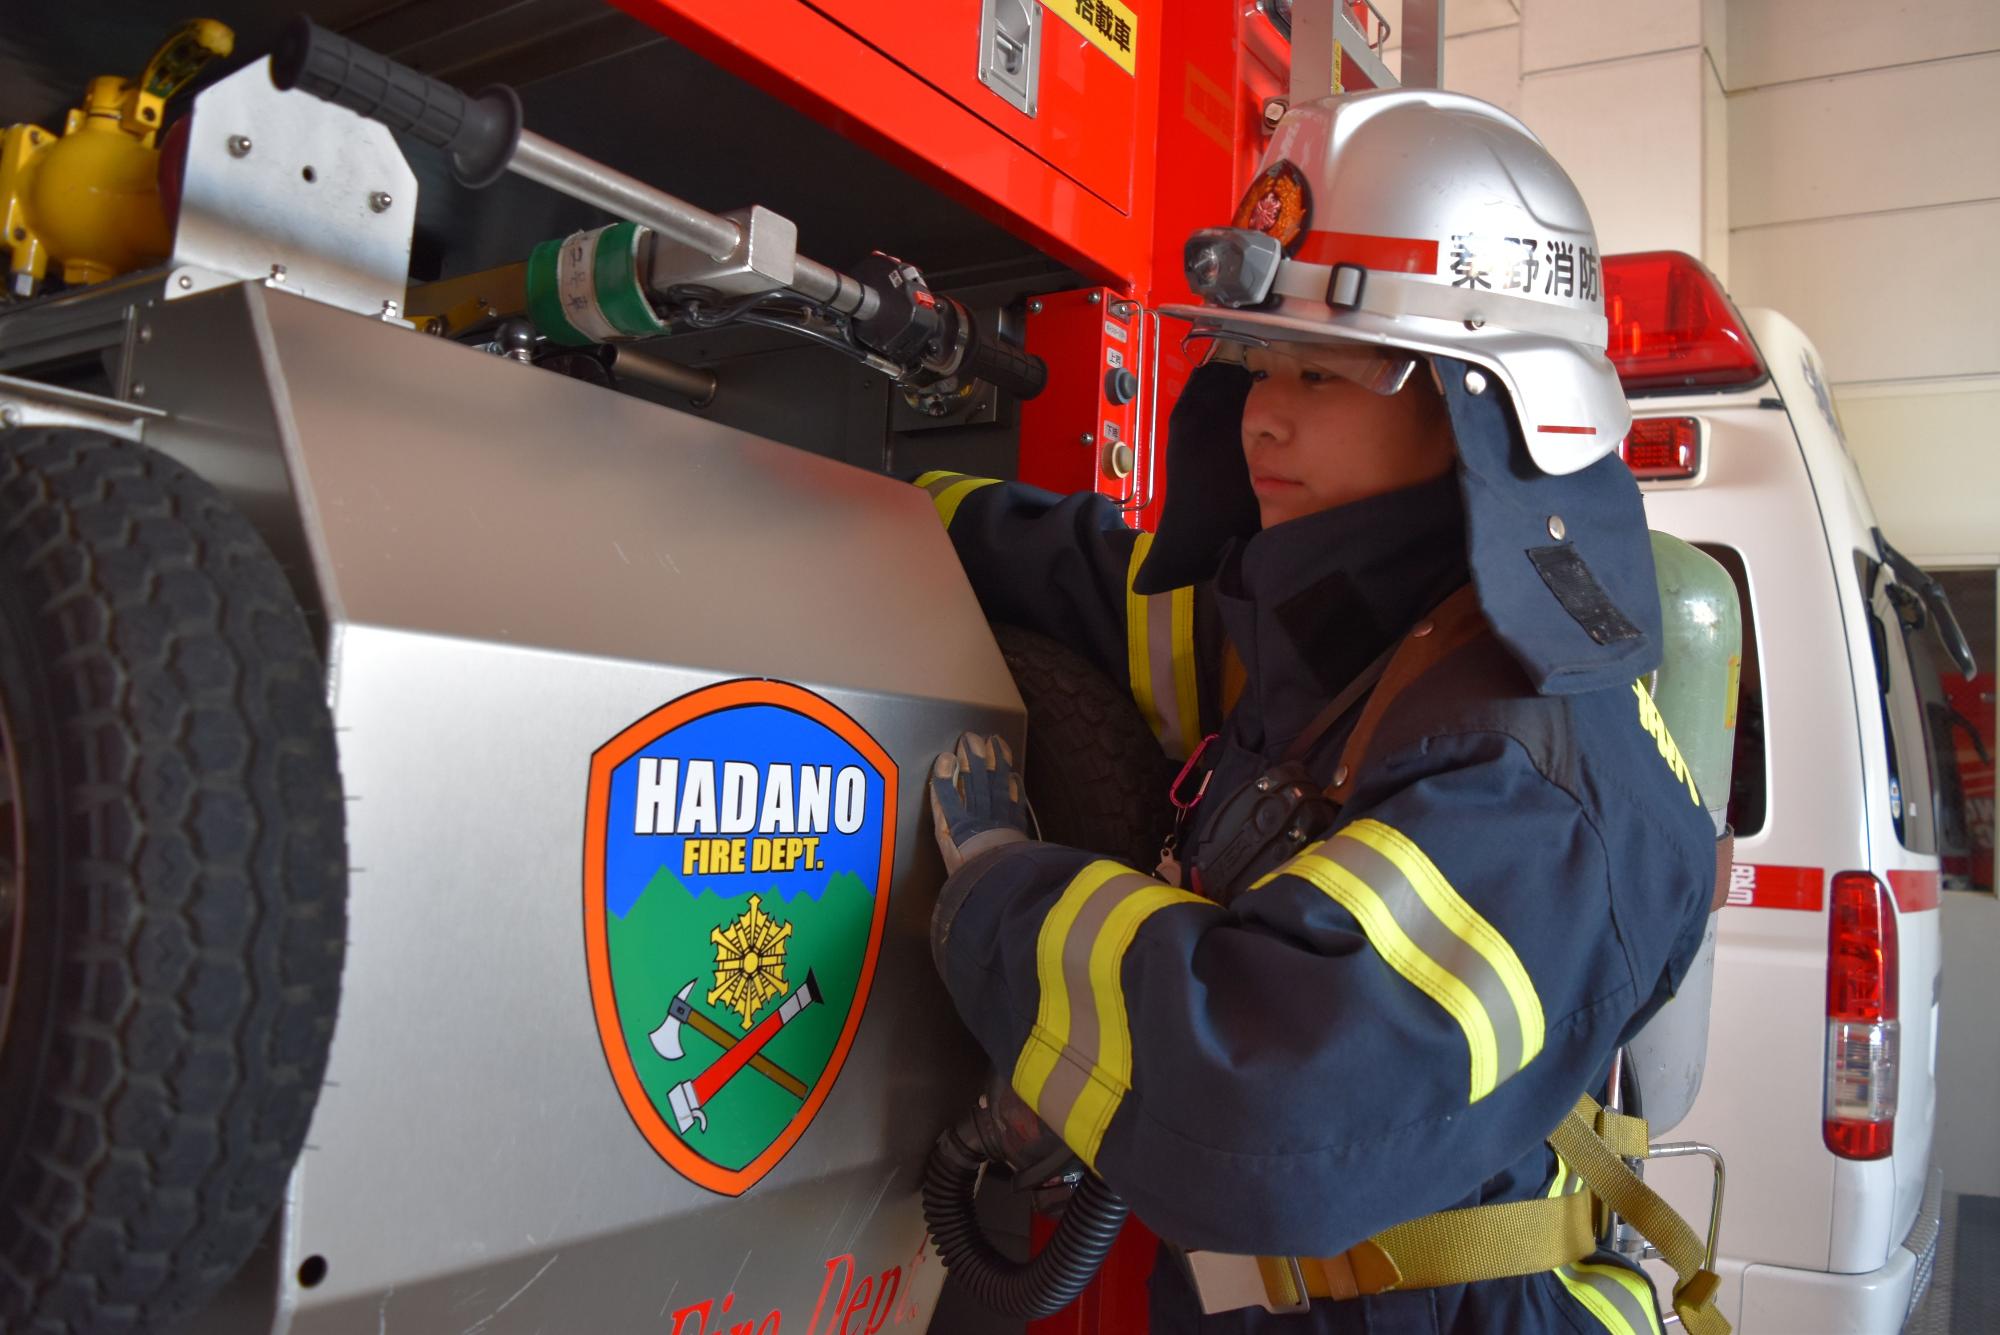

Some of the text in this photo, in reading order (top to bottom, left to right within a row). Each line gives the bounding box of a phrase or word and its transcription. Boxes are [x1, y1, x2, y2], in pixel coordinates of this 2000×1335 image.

[634, 757, 867, 835] HADANO
[682, 836, 824, 875] FIRE DEPT.
